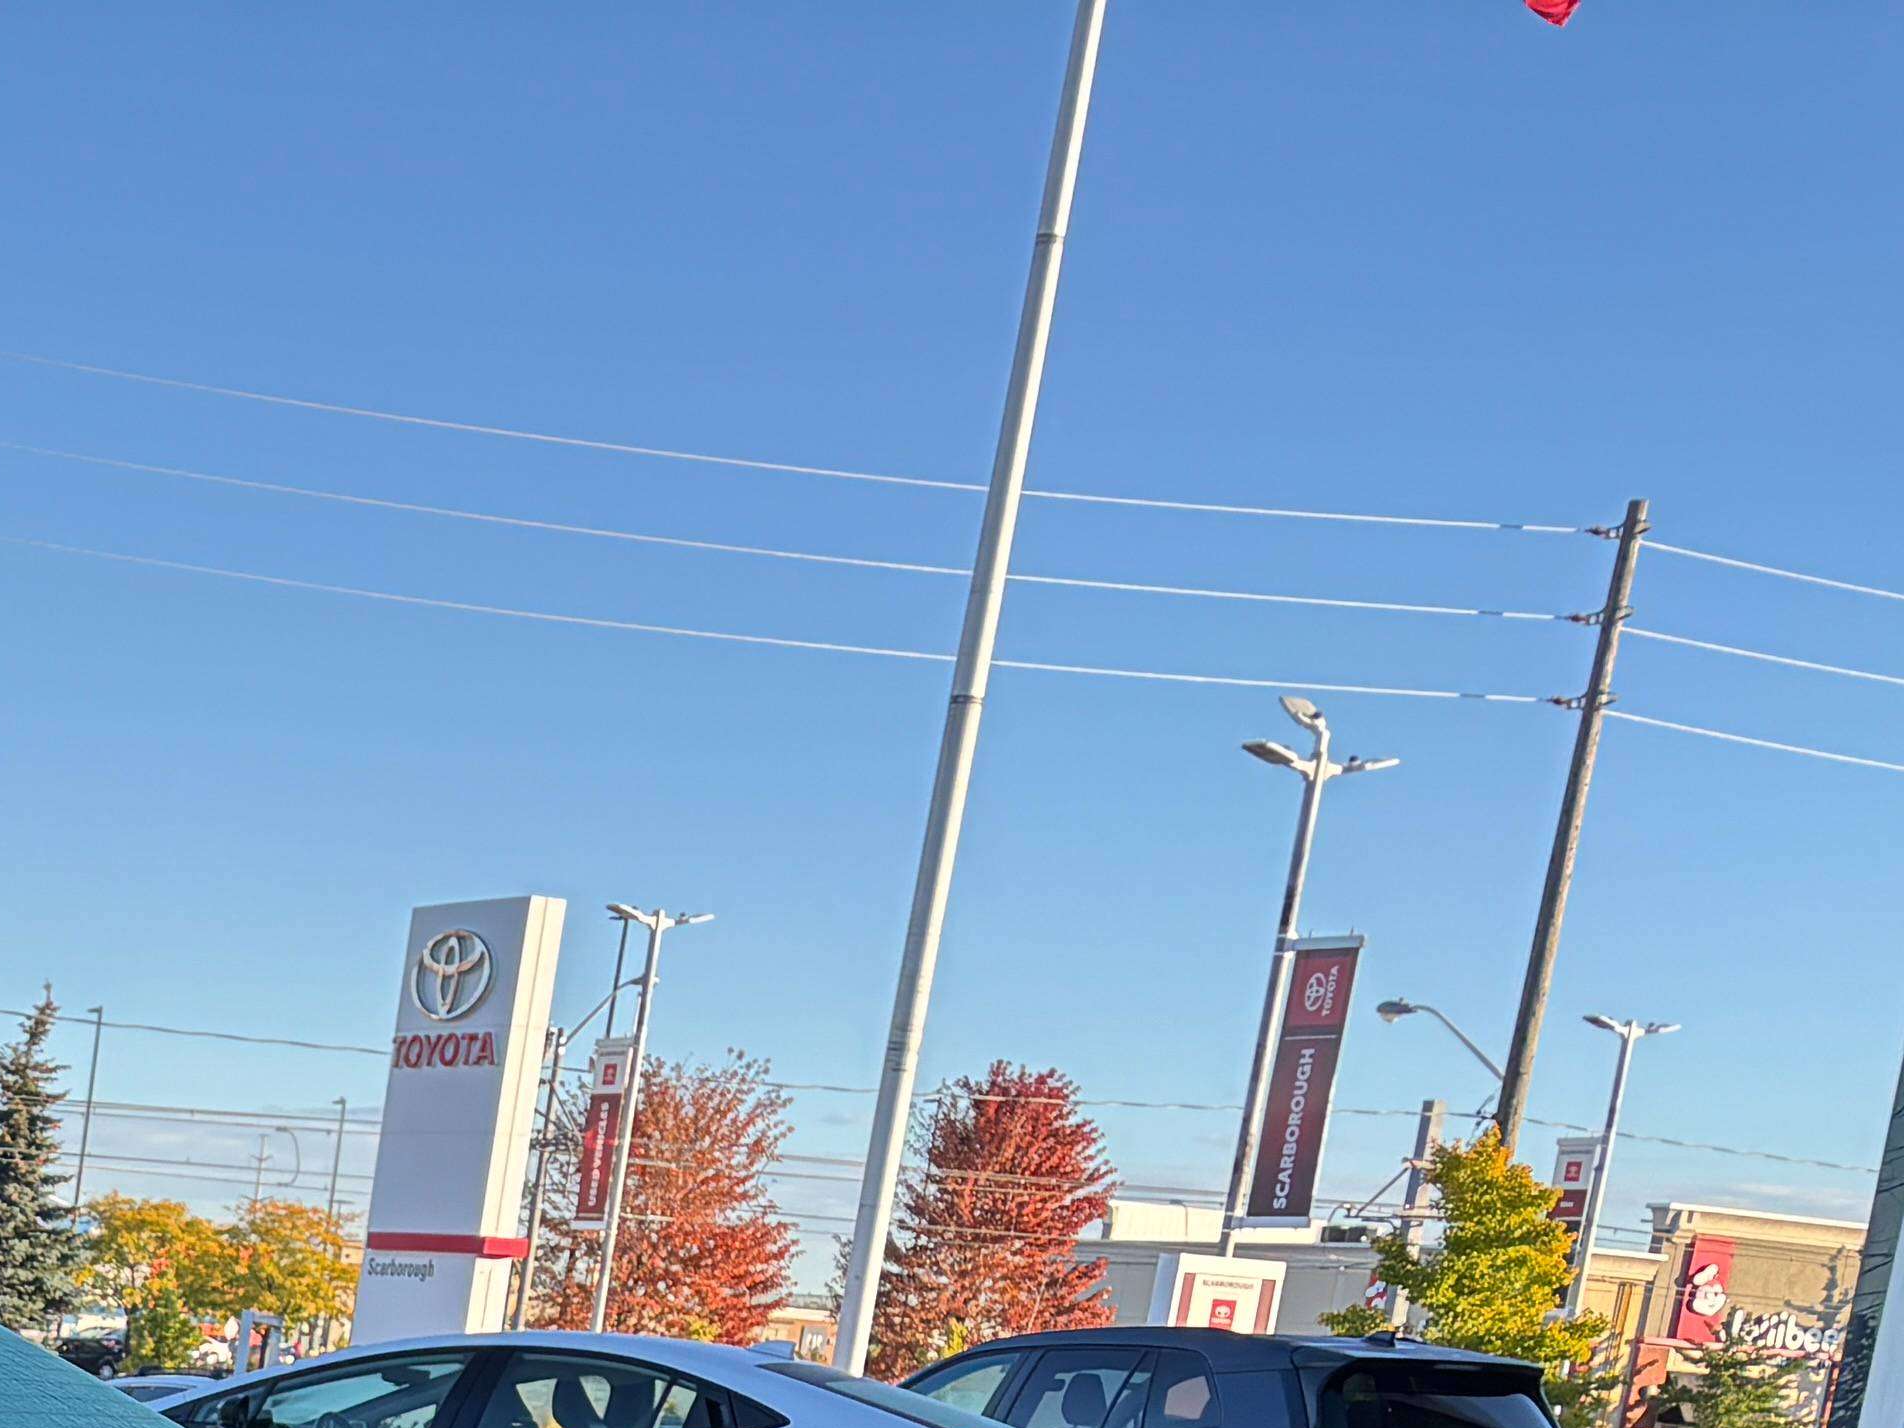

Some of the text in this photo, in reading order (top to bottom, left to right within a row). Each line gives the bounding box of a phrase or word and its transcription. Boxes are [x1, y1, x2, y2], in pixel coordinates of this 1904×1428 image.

[1322, 965, 1340, 1017] TOYOTA
[392, 1031, 497, 1069] TOYOTA
[1273, 1048, 1316, 1210] SCARBOROUGH
[367, 1257, 435, 1283] Scarborough
